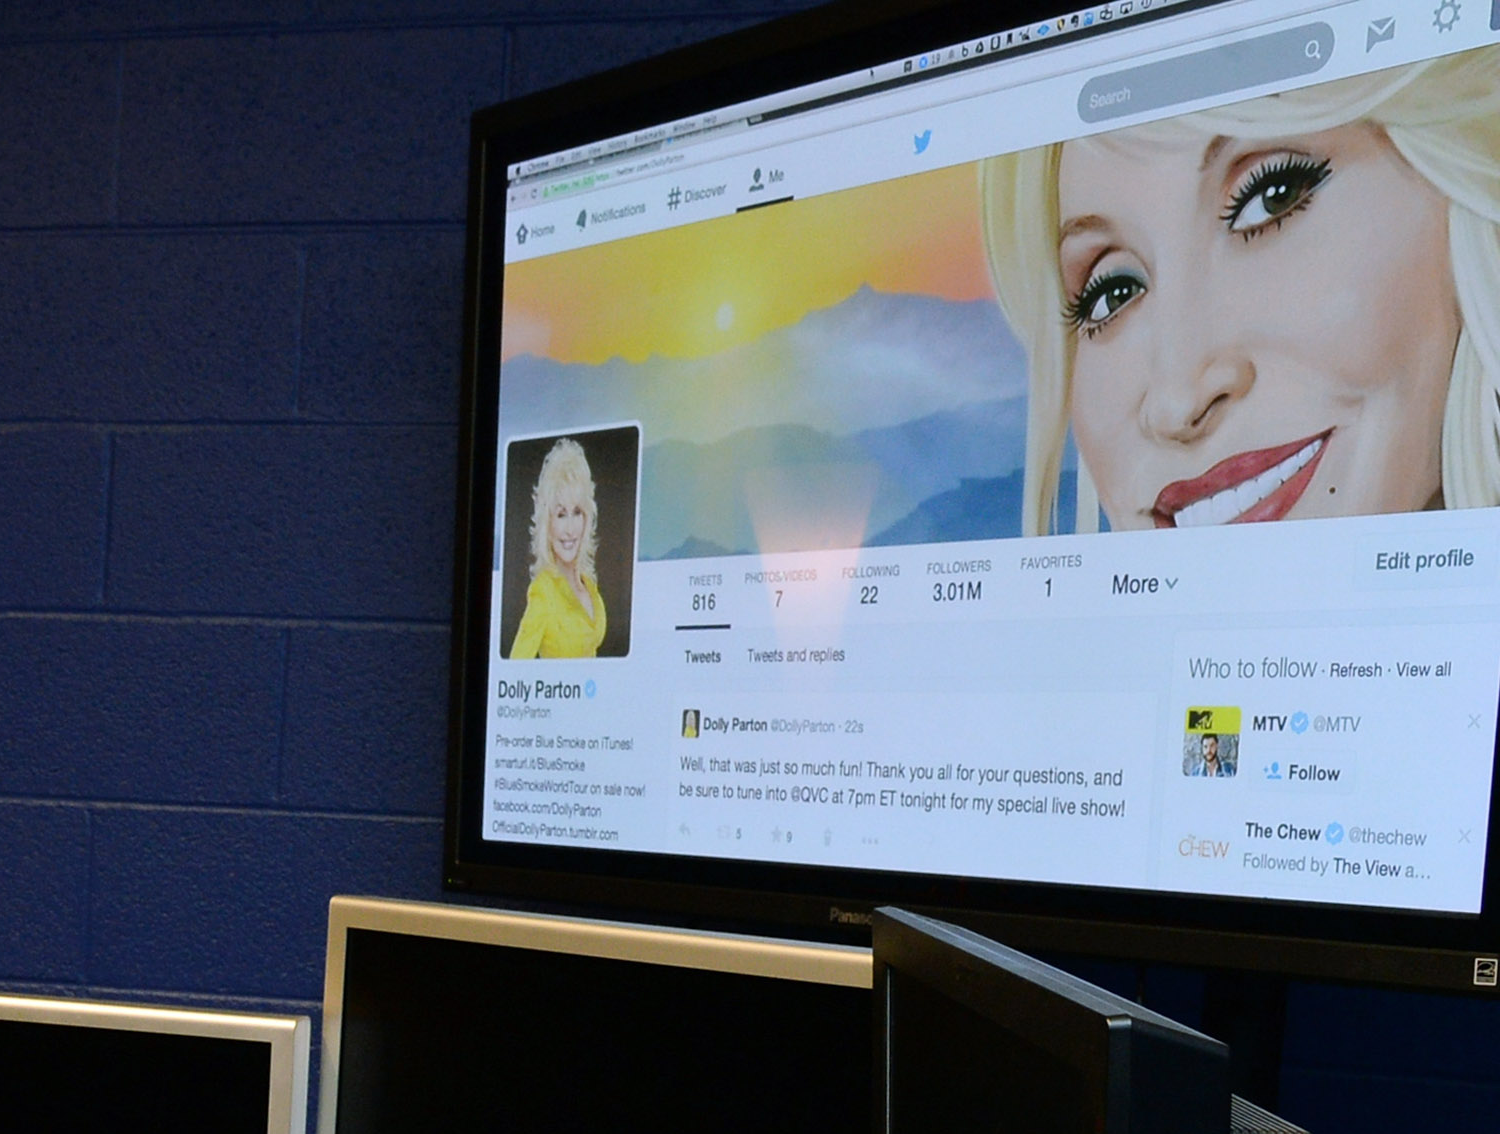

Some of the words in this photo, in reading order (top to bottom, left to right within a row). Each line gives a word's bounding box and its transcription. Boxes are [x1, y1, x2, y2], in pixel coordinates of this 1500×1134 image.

[1089, 86, 1131, 109] Search
[769, 169, 785, 184] Me
[684, 182, 727, 203] Discover
[590, 201, 646, 225] Notifications
[530, 223, 555, 239] Home
[927, 559, 992, 575] FOLLOWERS
[1020, 554, 1082, 570] FAVORITES
[1376, 551, 1411, 570] Edit
[1415, 548, 1474, 573] profile
[689, 573, 722, 587] TWEETS
[842, 564, 900, 580] FOLLOWING
[933, 581, 982, 602] 3.01M
[1044, 577, 1052, 597] 1
[1112, 573, 1159, 595] More
[692, 593, 716, 611] 816
[775, 590, 783, 608] 7
[860, 586, 879, 605] 22
[685, 649, 722, 664] Tweets
[748, 647, 784, 663] Tweets
[786, 648, 807, 663] and
[809, 647, 845, 664] replies
[1188, 657, 1231, 679] Who
[1237, 659, 1255, 679] to
[1262, 657, 1317, 679] follow
[1330, 661, 1382, 678] Refresh
[1396, 661, 1431, 677] View
[1435, 660, 1452, 677] all
[498, 680, 531, 702] Dolly
[535, 680, 581, 700] Parton
[703, 716, 729, 734] Dolly
[732, 717, 768, 732] Parton
[844, 719, 864, 734] 22s
[1252, 715, 1287, 732] MTV
[1313, 715, 1361, 733] @MTV
[495, 734, 534, 748] Pre-order
[535, 735, 554, 748] Blue
[556, 736, 586, 749] Smoke
[588, 739, 599, 749] on
[601, 736, 633, 750] iTunes!
[680, 756, 706, 773] Well,
[709, 756, 731, 773] that
[734, 762, 757, 774] was
[759, 758, 780, 777] just
[784, 762, 798, 775] so
[801, 760, 836, 776] much
[839, 760, 863, 777] fun!
[866, 761, 905, 779] Thank
[909, 766, 933, 783] you
[937, 763, 952, 780] all
[956, 763, 974, 781] for
[978, 768, 1009, 785] your
[1013, 766, 1088, 788] questions,
[1093, 768, 1123, 786] and
[1288, 764, 1341, 782] Follow
[590, 785, 600, 795] on
[604, 783, 623, 797] sale
[624, 783, 647, 798] now!
[679, 782, 694, 797] be
[696, 786, 719, 798] sure
[722, 785, 734, 799] to
[737, 785, 762, 800] tune
[765, 785, 787, 801] into
[790, 785, 828, 804] @QVC
[832, 789, 844, 804] at
[848, 789, 876, 809] 7pm
[880, 790, 897, 806] ET
[900, 791, 946, 812] tonight
[950, 792, 968, 809] for
[972, 798, 993, 815] my
[997, 796, 1047, 815] special
[1051, 796, 1076, 815] live
[1080, 800, 1125, 817] show!
[786, 831, 793, 843] 9
[1245, 822, 1273, 839] The
[1277, 823, 1321, 842] Chew
[1349, 826, 1427, 847] @thechew
[1178, 837, 1230, 859] CHEW
[1243, 852, 1306, 872] Followed
[1310, 855, 1329, 877] by
[1333, 857, 1361, 875] The
[1365, 858, 1401, 878] View
[830, 907, 872, 925] Panaso
